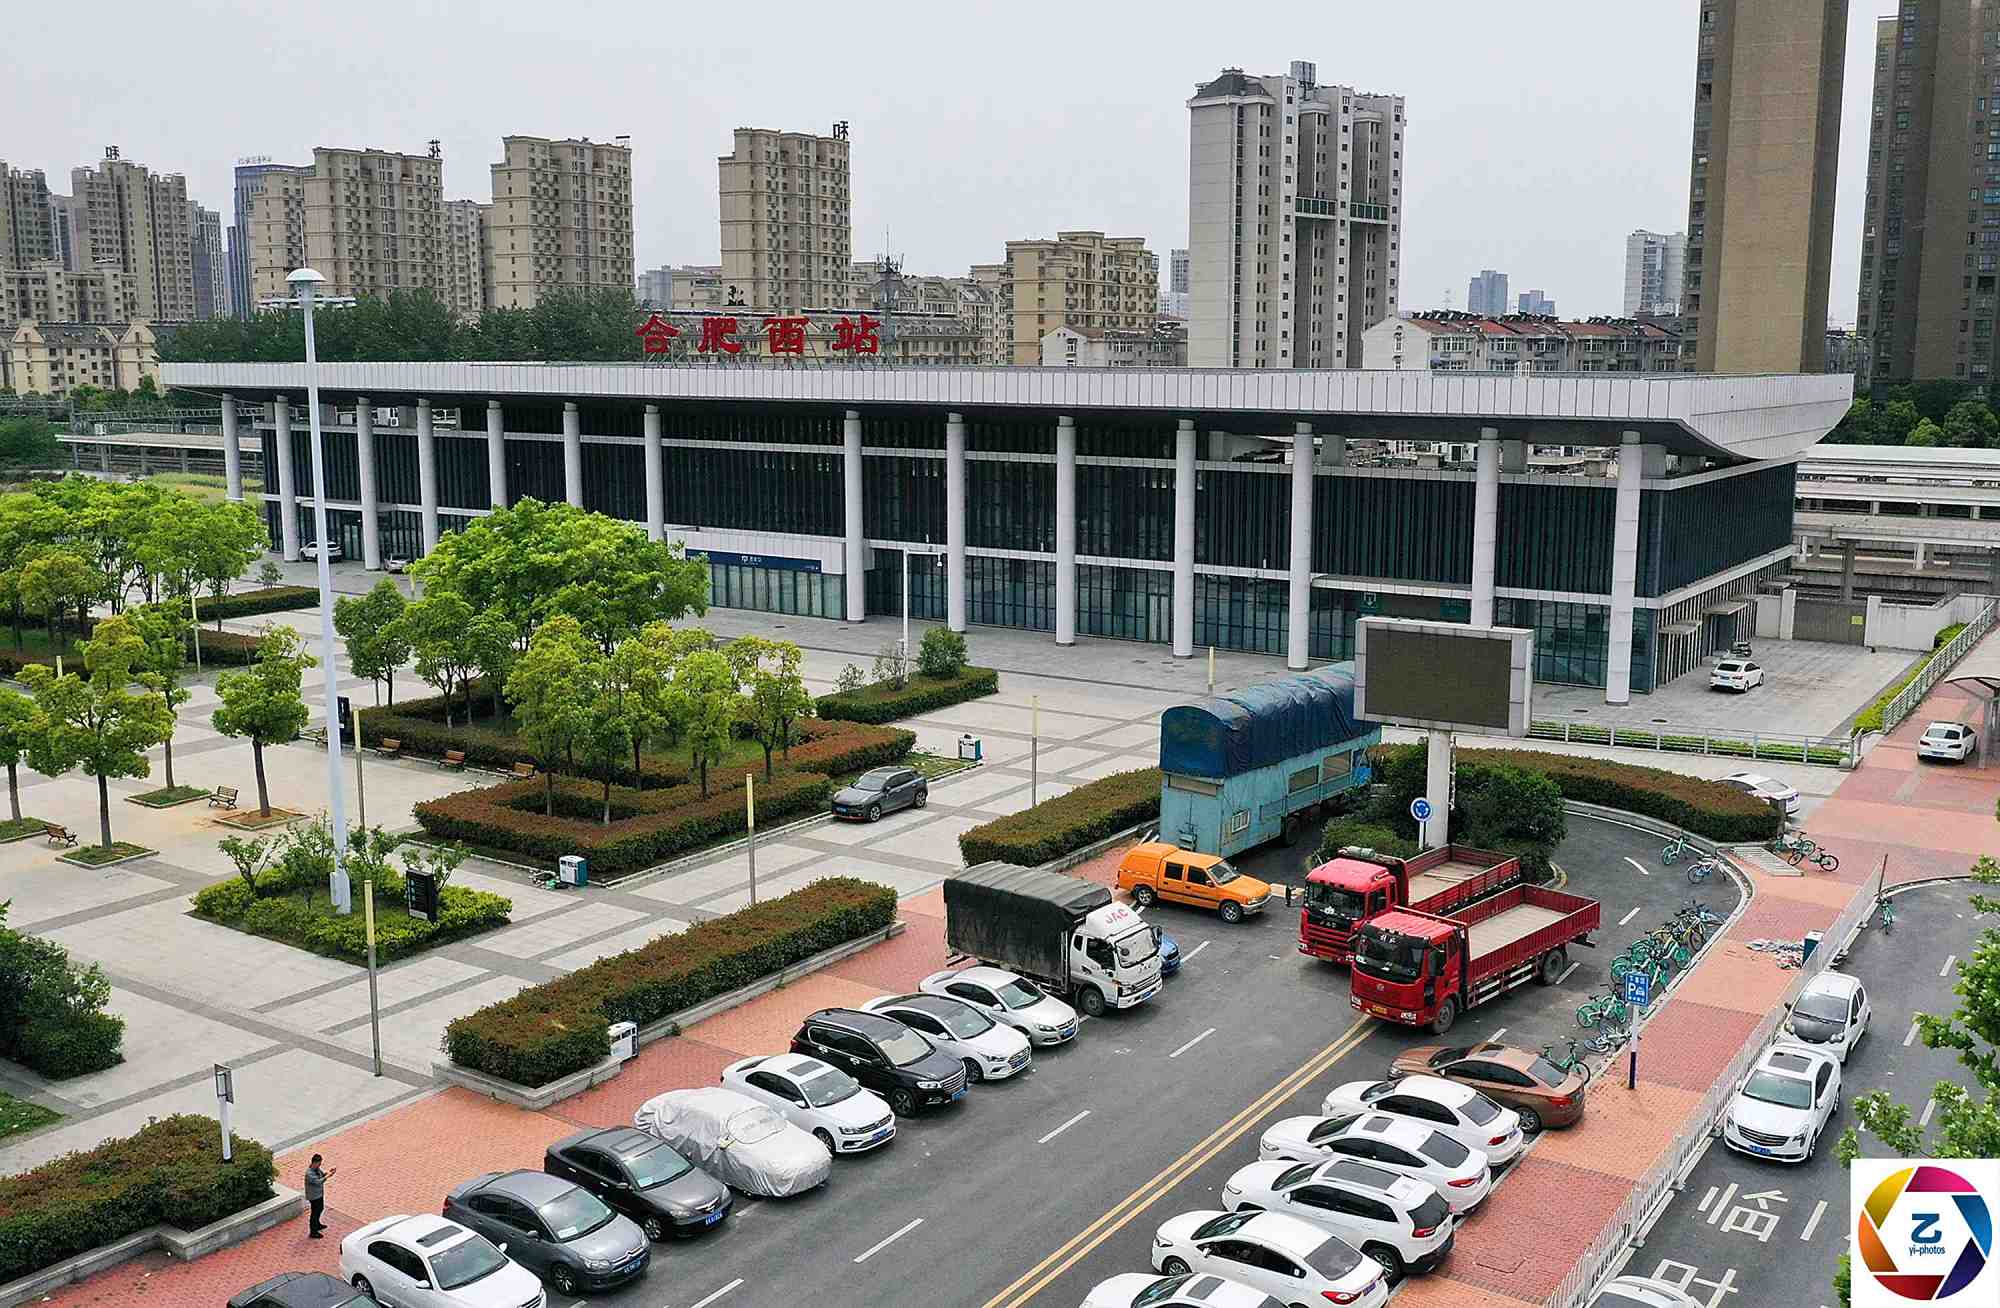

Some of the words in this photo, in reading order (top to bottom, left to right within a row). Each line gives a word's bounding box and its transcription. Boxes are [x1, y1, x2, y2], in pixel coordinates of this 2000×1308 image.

[635, 314, 880, 353] 合肥西站
[1105, 908, 1129, 925] JAC
[1628, 982, 1637, 995] P
